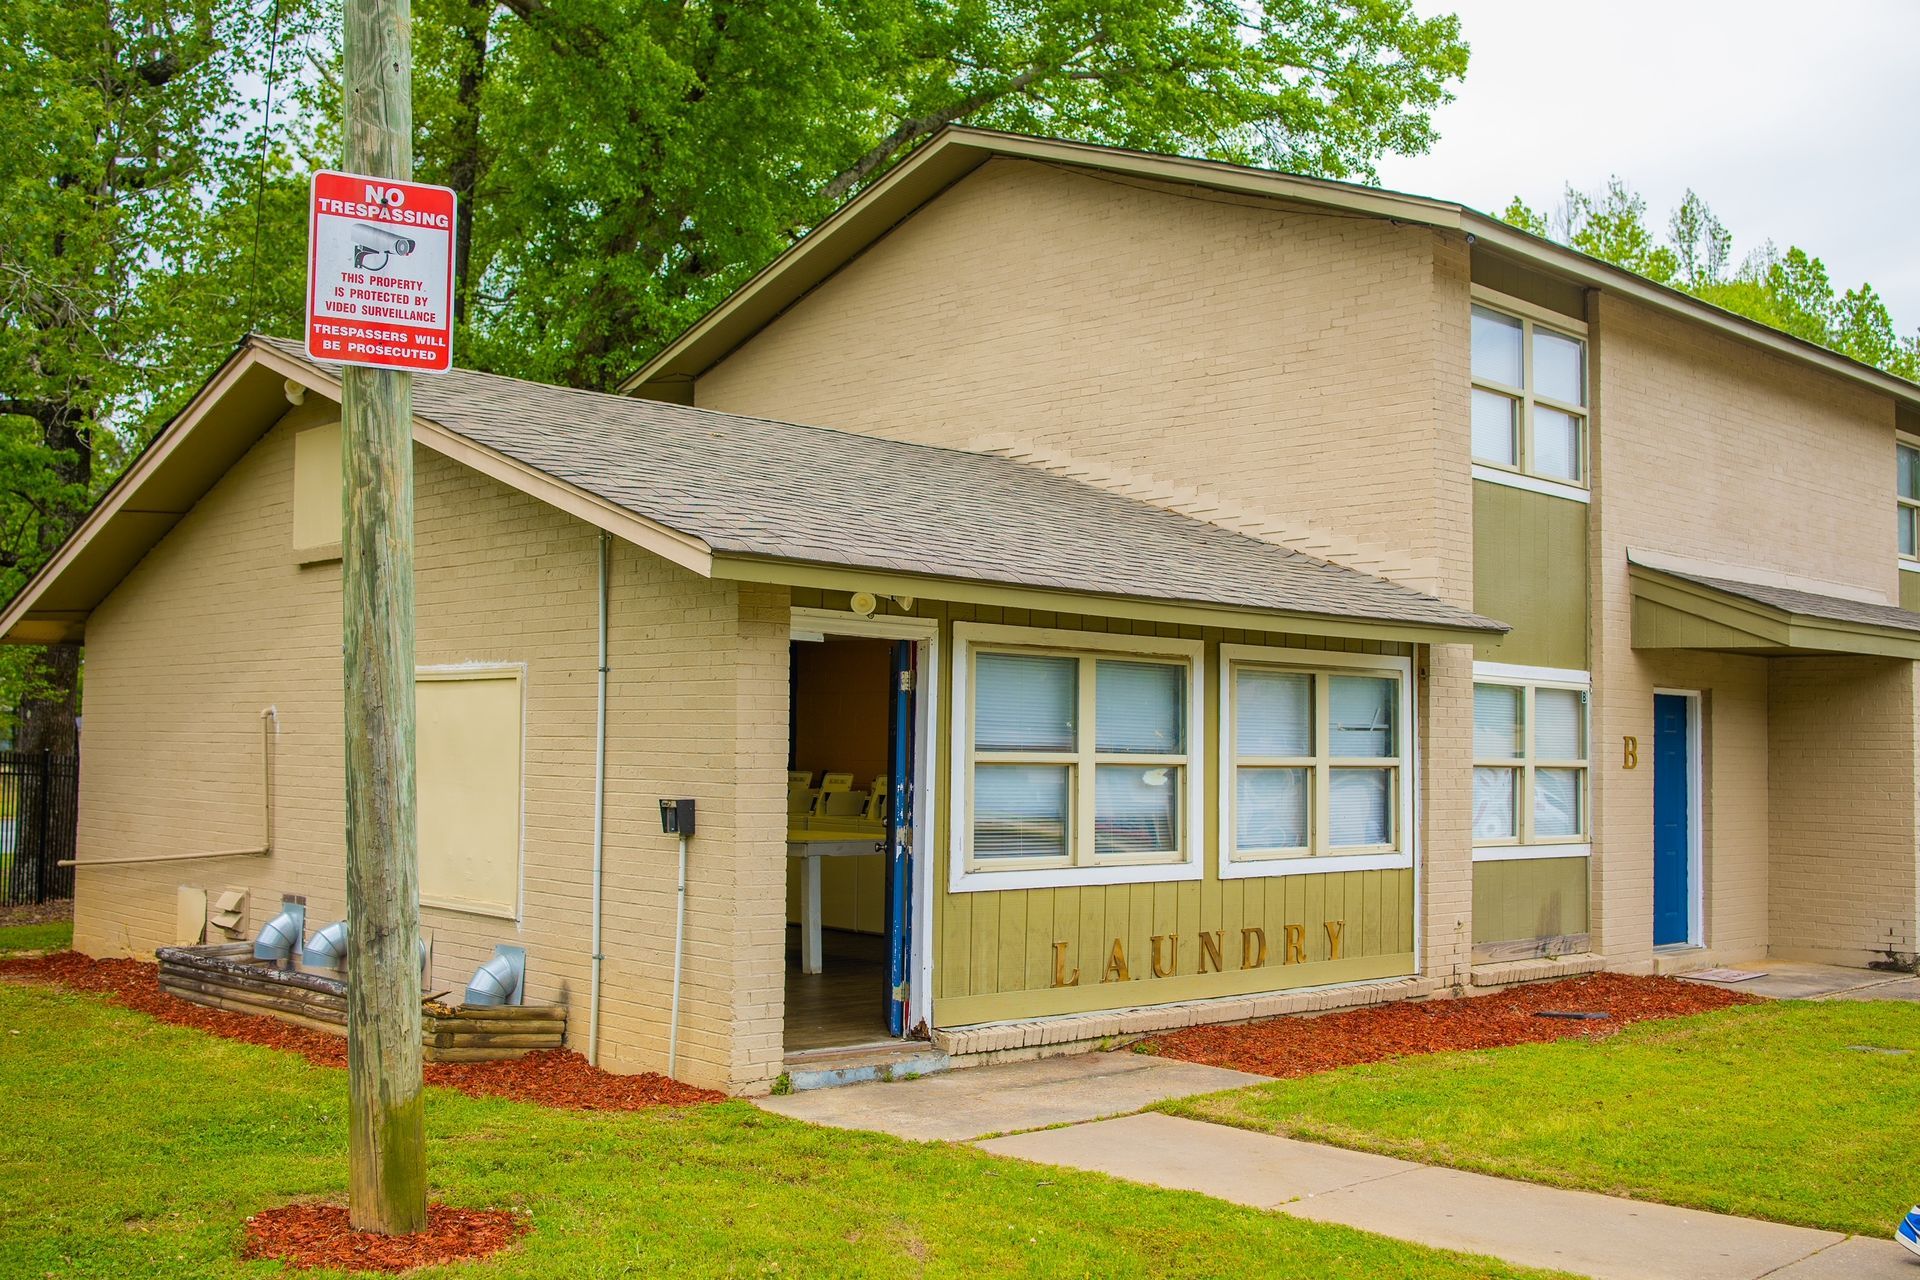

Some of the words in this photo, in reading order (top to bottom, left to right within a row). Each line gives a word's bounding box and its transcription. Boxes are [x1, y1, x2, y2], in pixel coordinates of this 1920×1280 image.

[365, 185, 405, 207] NO
[318, 198, 449, 228] TRESPASSING
[341, 272, 364, 284] THIS
[370, 276, 423, 291] PROPERTY
[335, 287, 344, 297] IS
[350, 289, 409, 304] PROTECTED
[415, 297, 428, 306] BY
[326, 301, 356, 314] VIDEO
[362, 306, 436, 323] SURVEILLANCE
[314, 324, 407, 342] TRESPASSERS
[415, 335, 445, 347] WILL
[323, 341, 341, 350] BE
[348, 342, 436, 361] PROSECUTED
[1622, 736, 1638, 769] B
[1050, 919, 1345, 988] LAUNDRY
